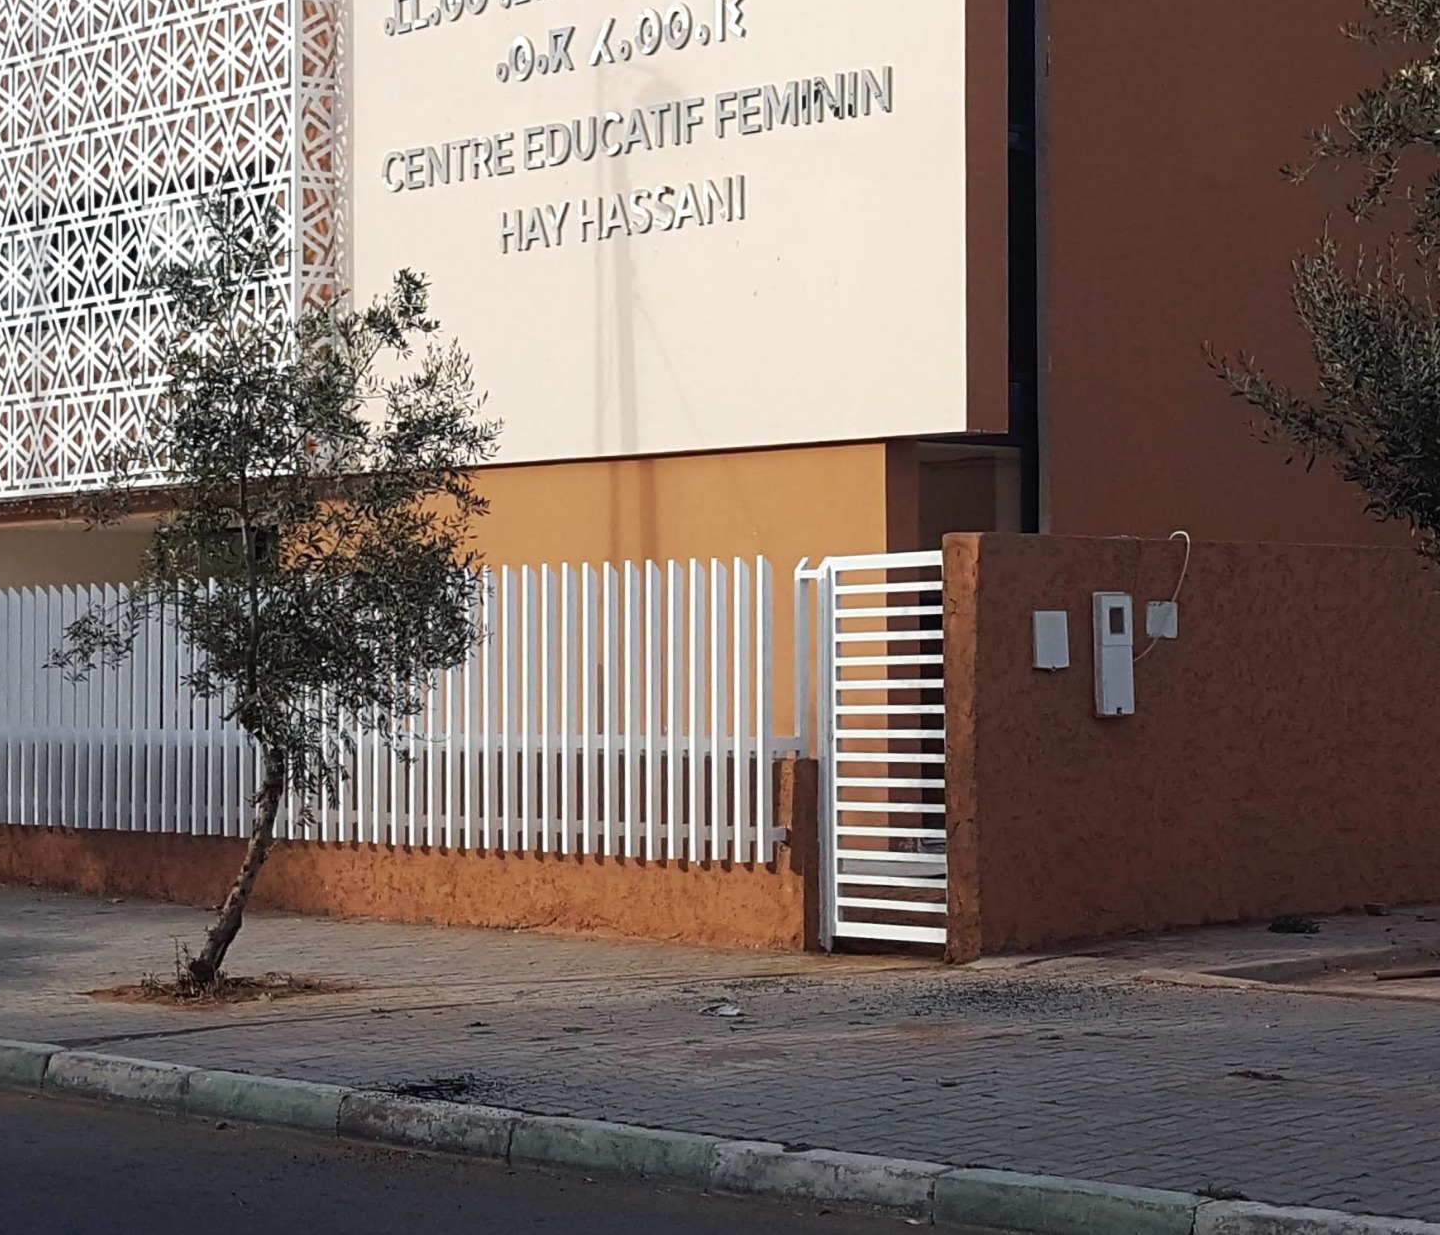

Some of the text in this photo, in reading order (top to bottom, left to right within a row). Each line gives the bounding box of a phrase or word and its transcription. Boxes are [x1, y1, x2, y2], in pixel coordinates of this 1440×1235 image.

[381, 65, 893, 193] CENTRE EDUCATIF FEMININ
[499, 174, 746, 254] HAY HASSANI
